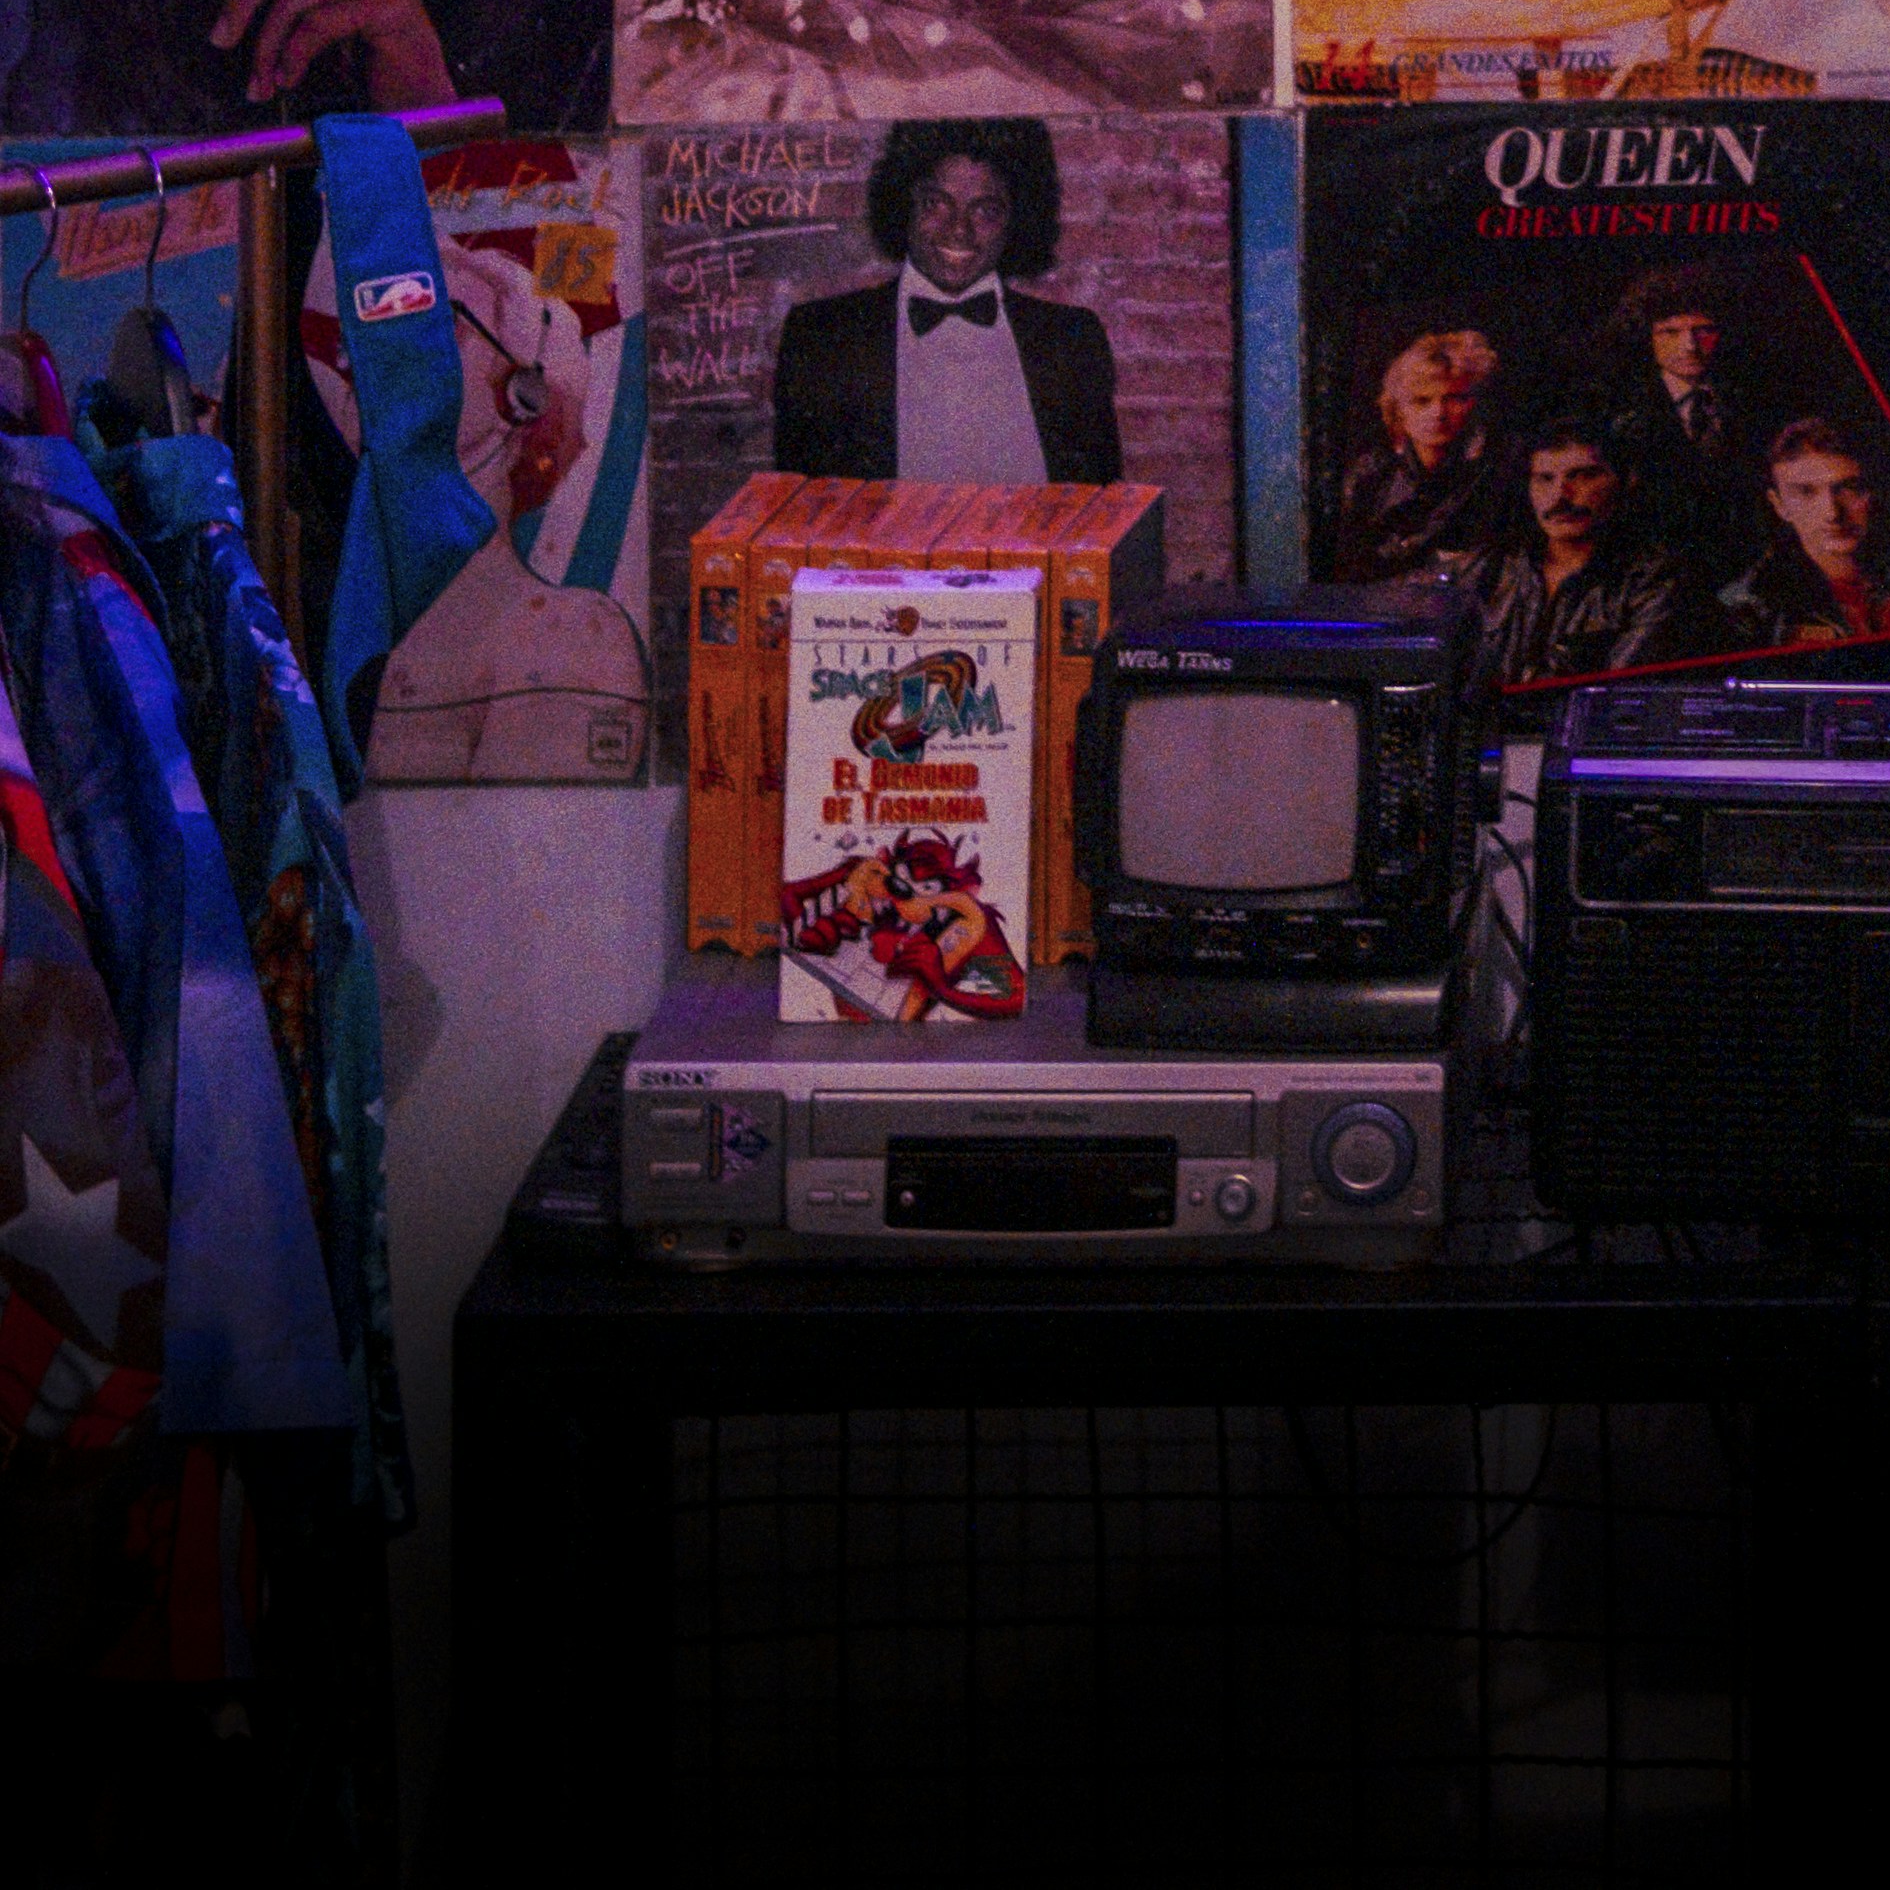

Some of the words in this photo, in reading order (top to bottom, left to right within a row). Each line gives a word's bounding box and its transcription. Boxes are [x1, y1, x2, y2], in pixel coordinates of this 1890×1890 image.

[664, 131, 853, 178] MICHAEL
[1483, 124, 1768, 208] QUEEN
[661, 180, 824, 229] JACKSON
[1474, 204, 1681, 239] GREATEST
[1686, 199, 1783, 237] HITS
[666, 248, 755, 297] OFF
[680, 291, 760, 338] THE
[656, 340, 760, 389] WALL
[809, 668, 899, 703] SPACE
[862, 790, 989, 825] TASMANIA
[638, 1071, 718, 1086] SONY
